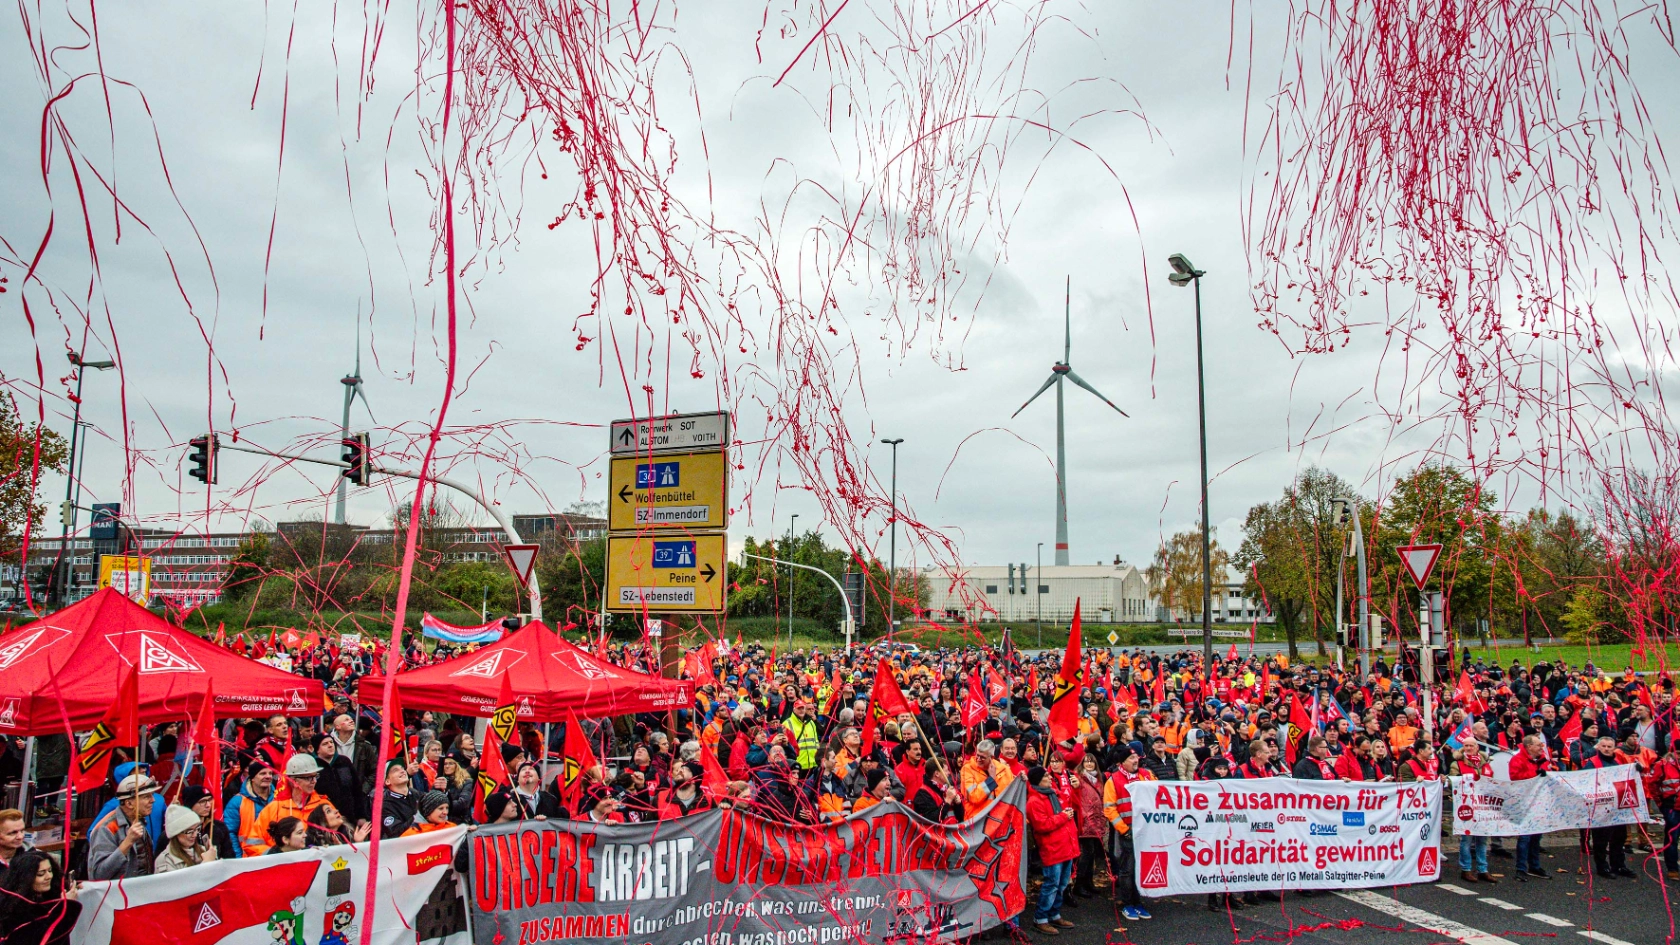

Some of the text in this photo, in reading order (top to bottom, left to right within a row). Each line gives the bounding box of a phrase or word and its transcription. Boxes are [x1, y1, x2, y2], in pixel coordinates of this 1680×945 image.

[640, 420, 697, 434] Rorwerk SOT
[692, 433, 716, 442] VOITH
[635, 490, 696, 503] Wolfenbüttel
[637, 508, 707, 521] SZ-Immendorf
[659, 551, 668, 559] 39
[669, 573, 697, 583] Peine
[241, 703, 284, 711] GUTES LEBEN
[1155, 784, 1209, 811] Alle
[1218, 792, 1350, 811] zusammen
[1357, 788, 1389, 811] für
[1478, 795, 1505, 806] MEHR
[1401, 811, 1432, 821] ALSTOM
[1250, 821, 1274, 831] MEIER
[1317, 824, 1338, 833] SMAG
[1379, 825, 1400, 833] BOSCH
[1181, 837, 1405, 869] Solidarität gewinnt!
[473, 829, 598, 913] UNSERE
[599, 837, 695, 902] ARBEIT
[715, 808, 847, 885] UNSERE
[1196, 870, 1386, 884] Vertrauensleute der IG Metall Salzgitter-Peine
[518, 911, 631, 945] ZUSAMMEN
[761, 900, 794, 916] was
[797, 900, 826, 915] uns
[740, 932, 774, 945] was
[777, 925, 818, 945] noch
